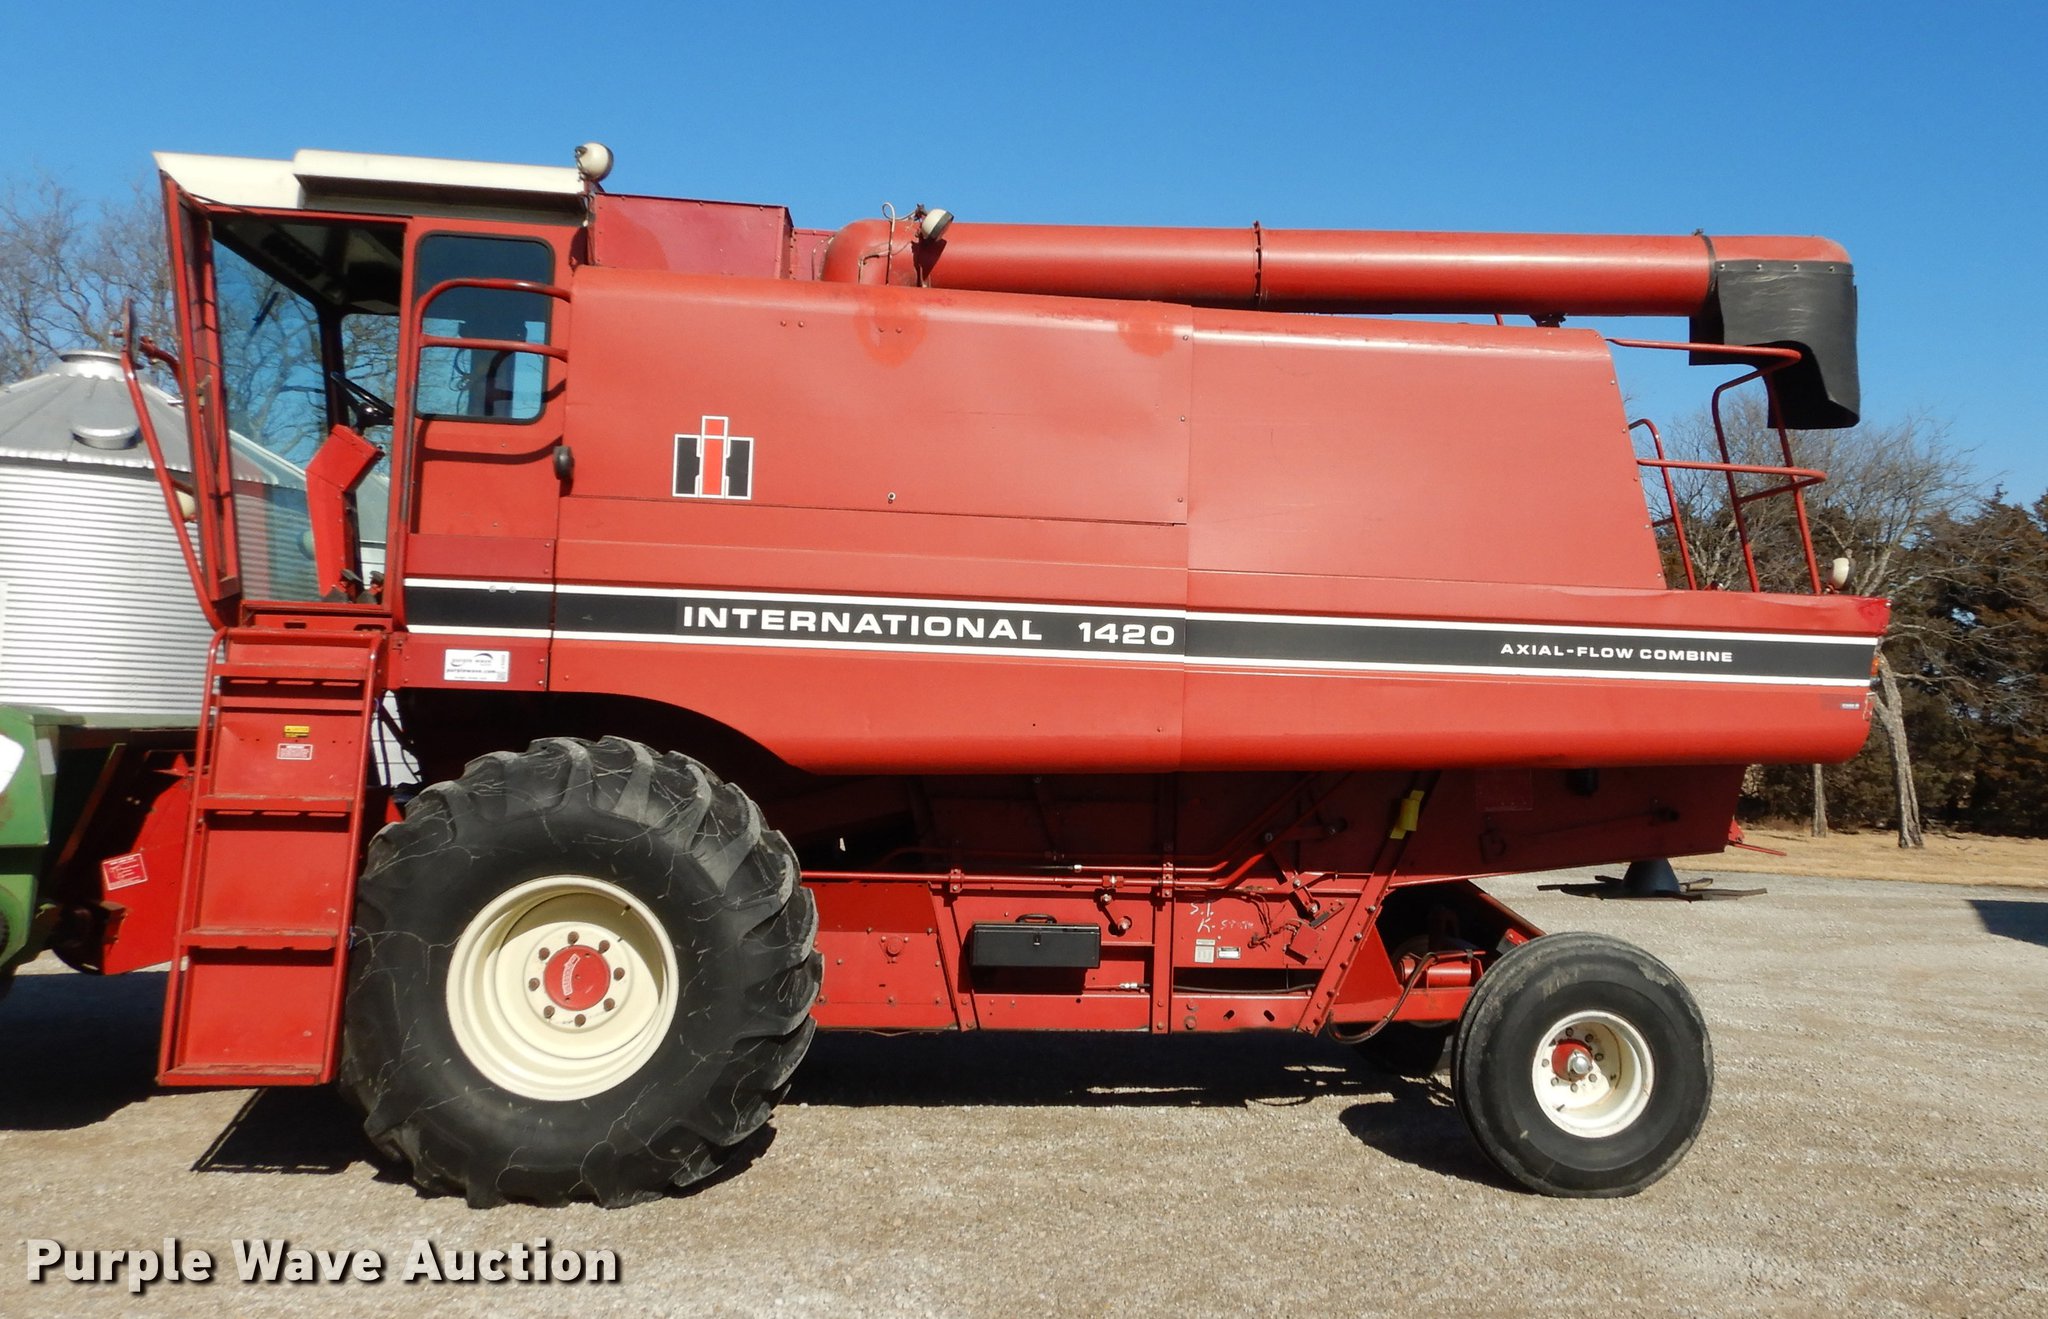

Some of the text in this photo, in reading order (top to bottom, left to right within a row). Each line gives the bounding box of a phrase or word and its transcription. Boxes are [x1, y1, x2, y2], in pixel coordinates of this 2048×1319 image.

[683, 606, 1175, 646] INTERNATIONAL 1420
[1500, 643, 1733, 663] AXIAL-FLOW COMBINE
